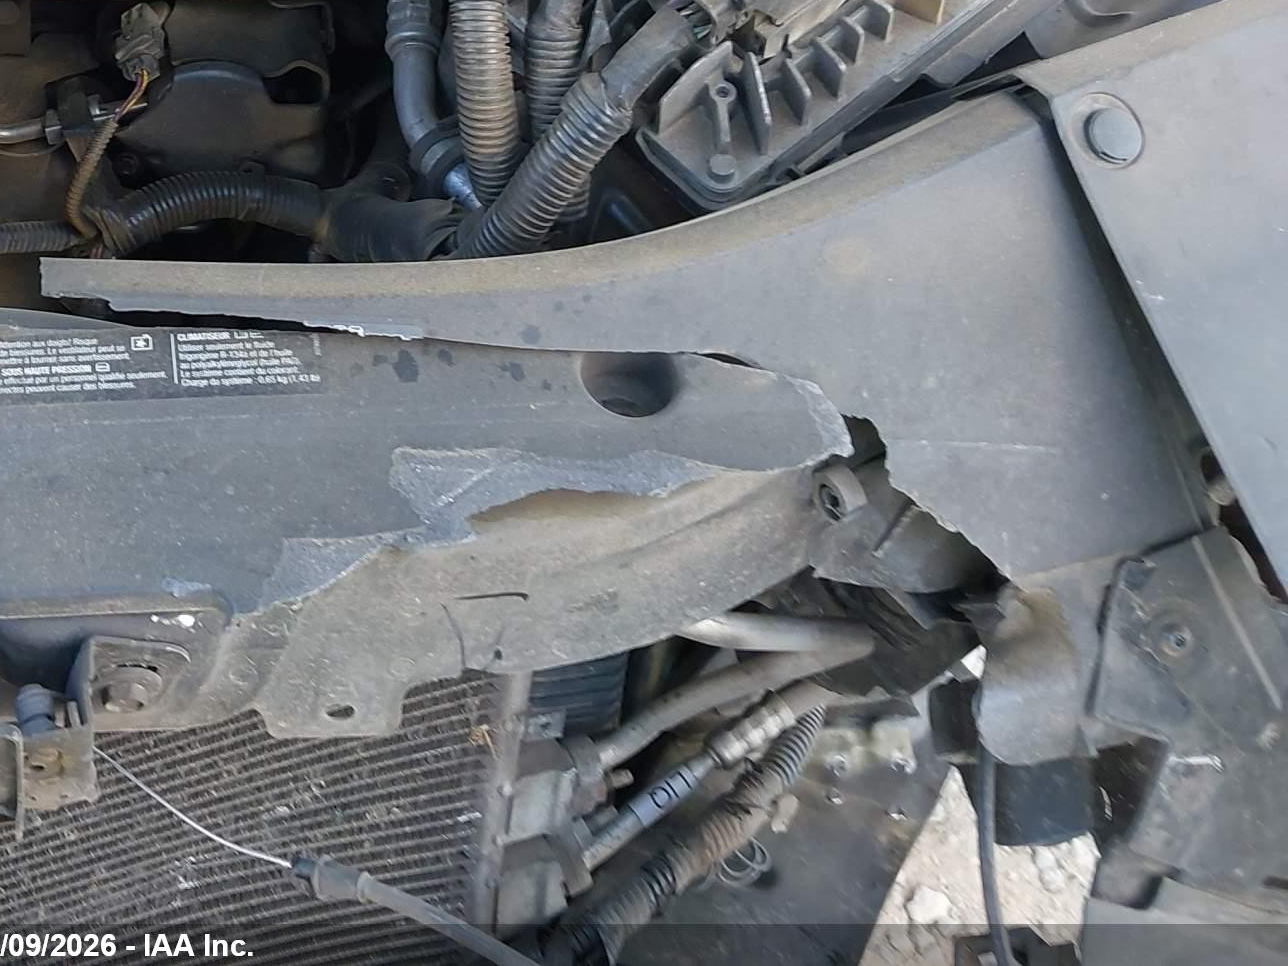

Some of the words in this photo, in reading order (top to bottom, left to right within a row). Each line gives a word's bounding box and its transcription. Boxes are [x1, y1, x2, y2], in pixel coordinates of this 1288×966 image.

[220, 350, 248, 358] R-134a
[1, 367, 24, 376] SOUS
[24, 366, 50, 375] HAUTE
[52, 364, 91, 374] PRESSION
[180, 370, 190, 378] Le
[277, 375, 288, 384] kg
